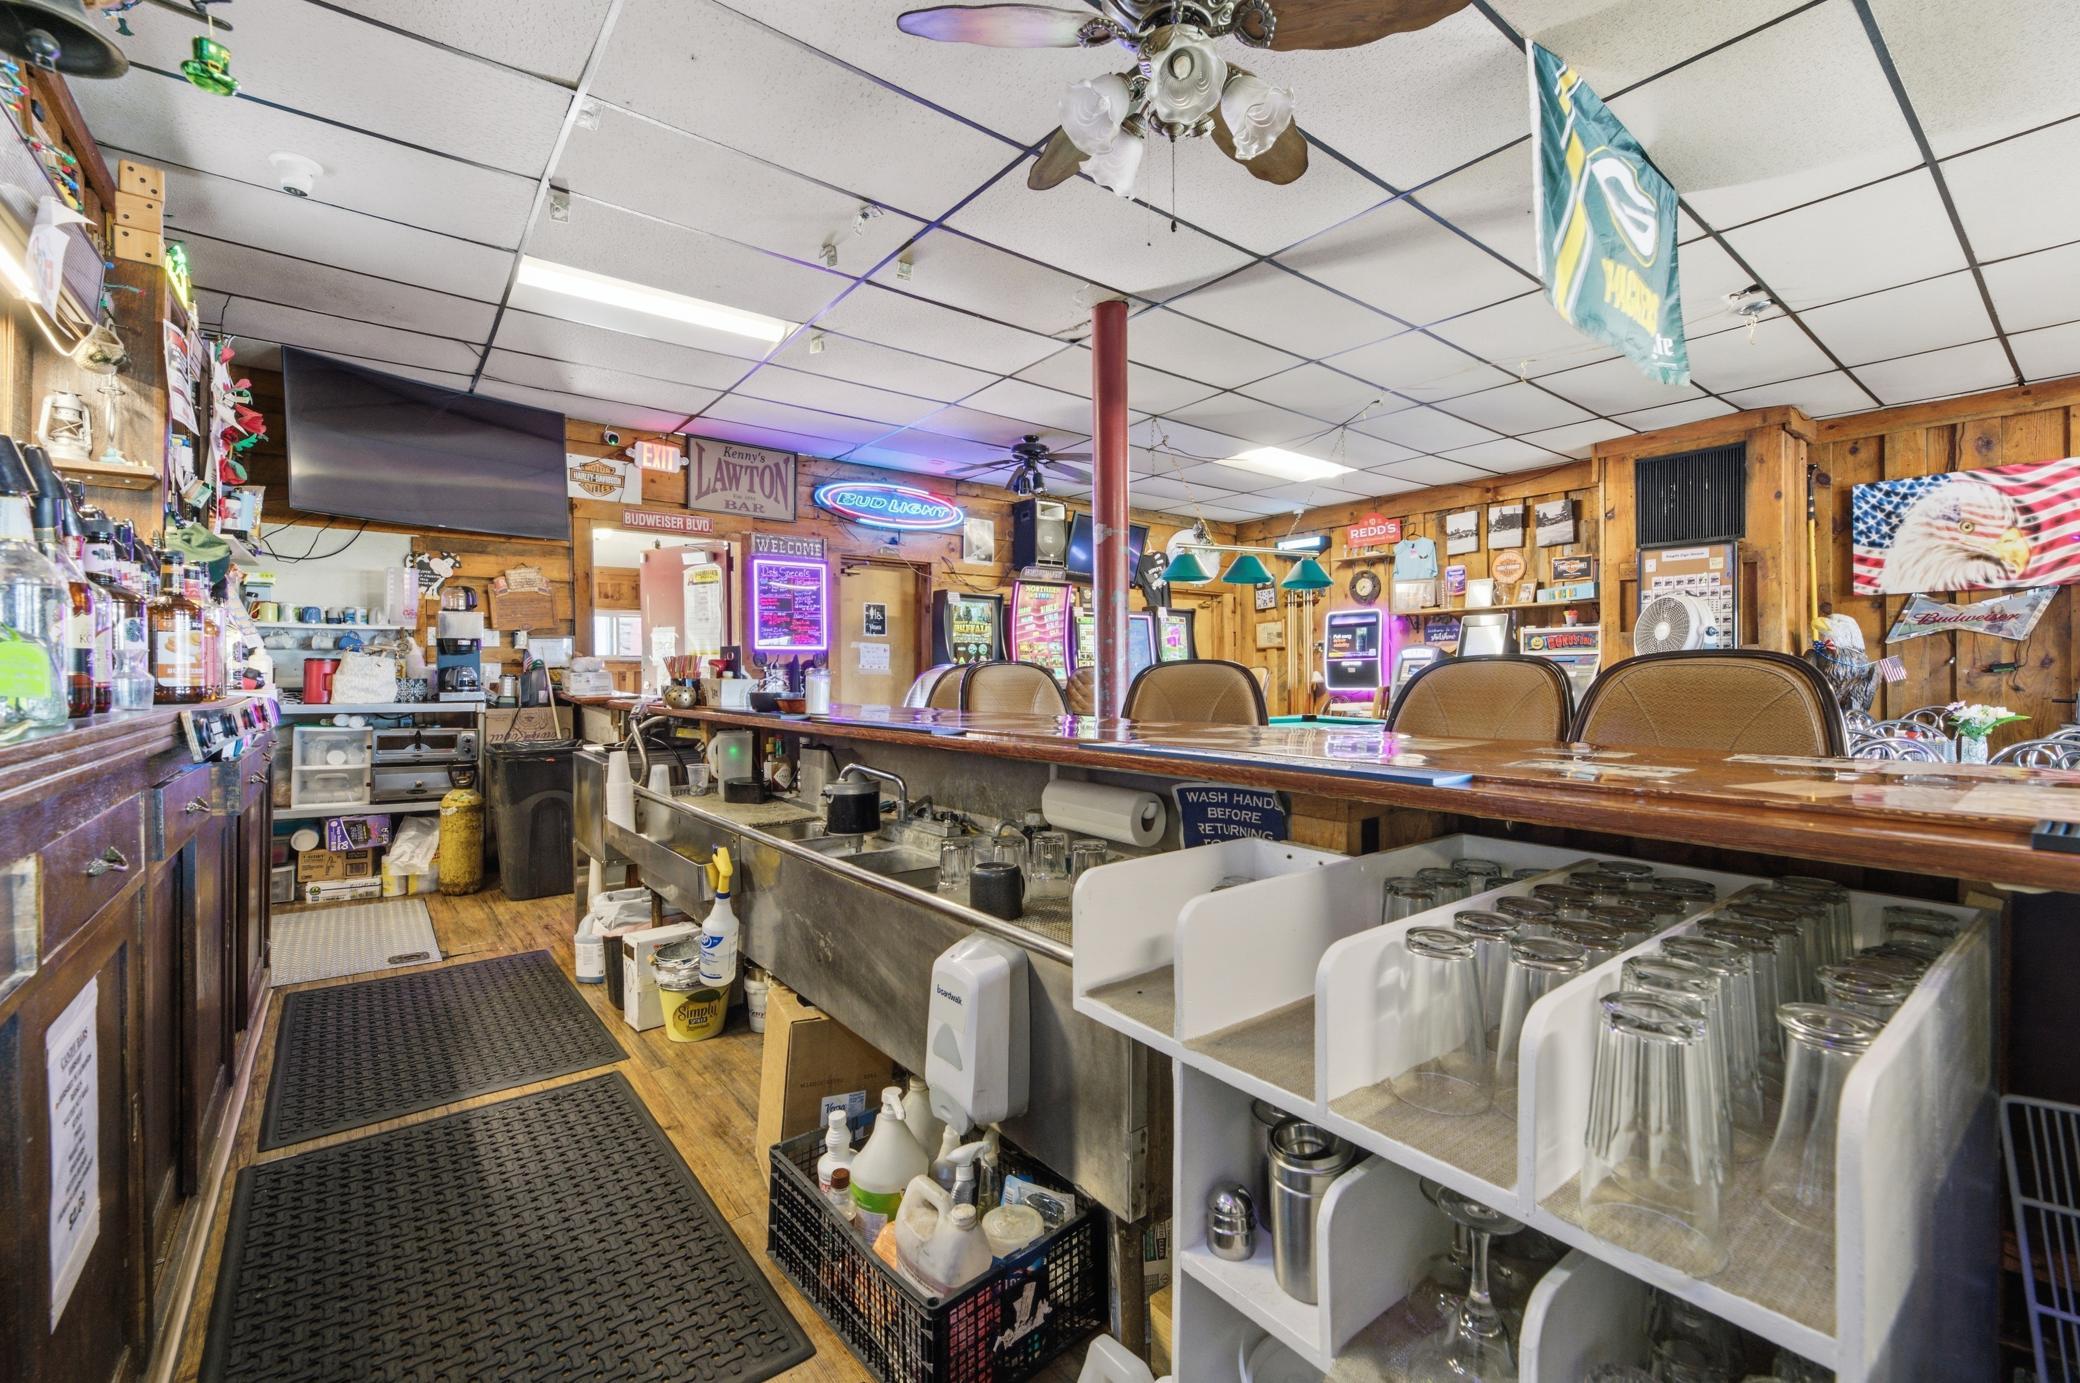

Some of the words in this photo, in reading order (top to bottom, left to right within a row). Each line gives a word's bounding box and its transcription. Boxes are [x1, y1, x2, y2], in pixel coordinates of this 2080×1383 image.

[643, 445, 673, 470] EXIT
[723, 446, 766, 464] Kenny's
[695, 441, 790, 511] LAWTON
[725, 500, 765, 513] BAR
[837, 492, 887, 509] BUD
[889, 499, 950, 518] LIGHT
[624, 512, 684, 529] BUDWEISER
[686, 518, 713, 531] BLVD.
[1350, 523, 1396, 539] REDD'S
[757, 538, 822, 556] WELCOME
[1914, 612, 2021, 625] Budweiser
[1187, 791, 1228, 803] WASH
[1207, 807, 1262, 824] BEFORE
[1198, 823, 1273, 841] RETURNING
[936, 983, 962, 1006] boardwalk
[678, 1002, 717, 1021] Simply
